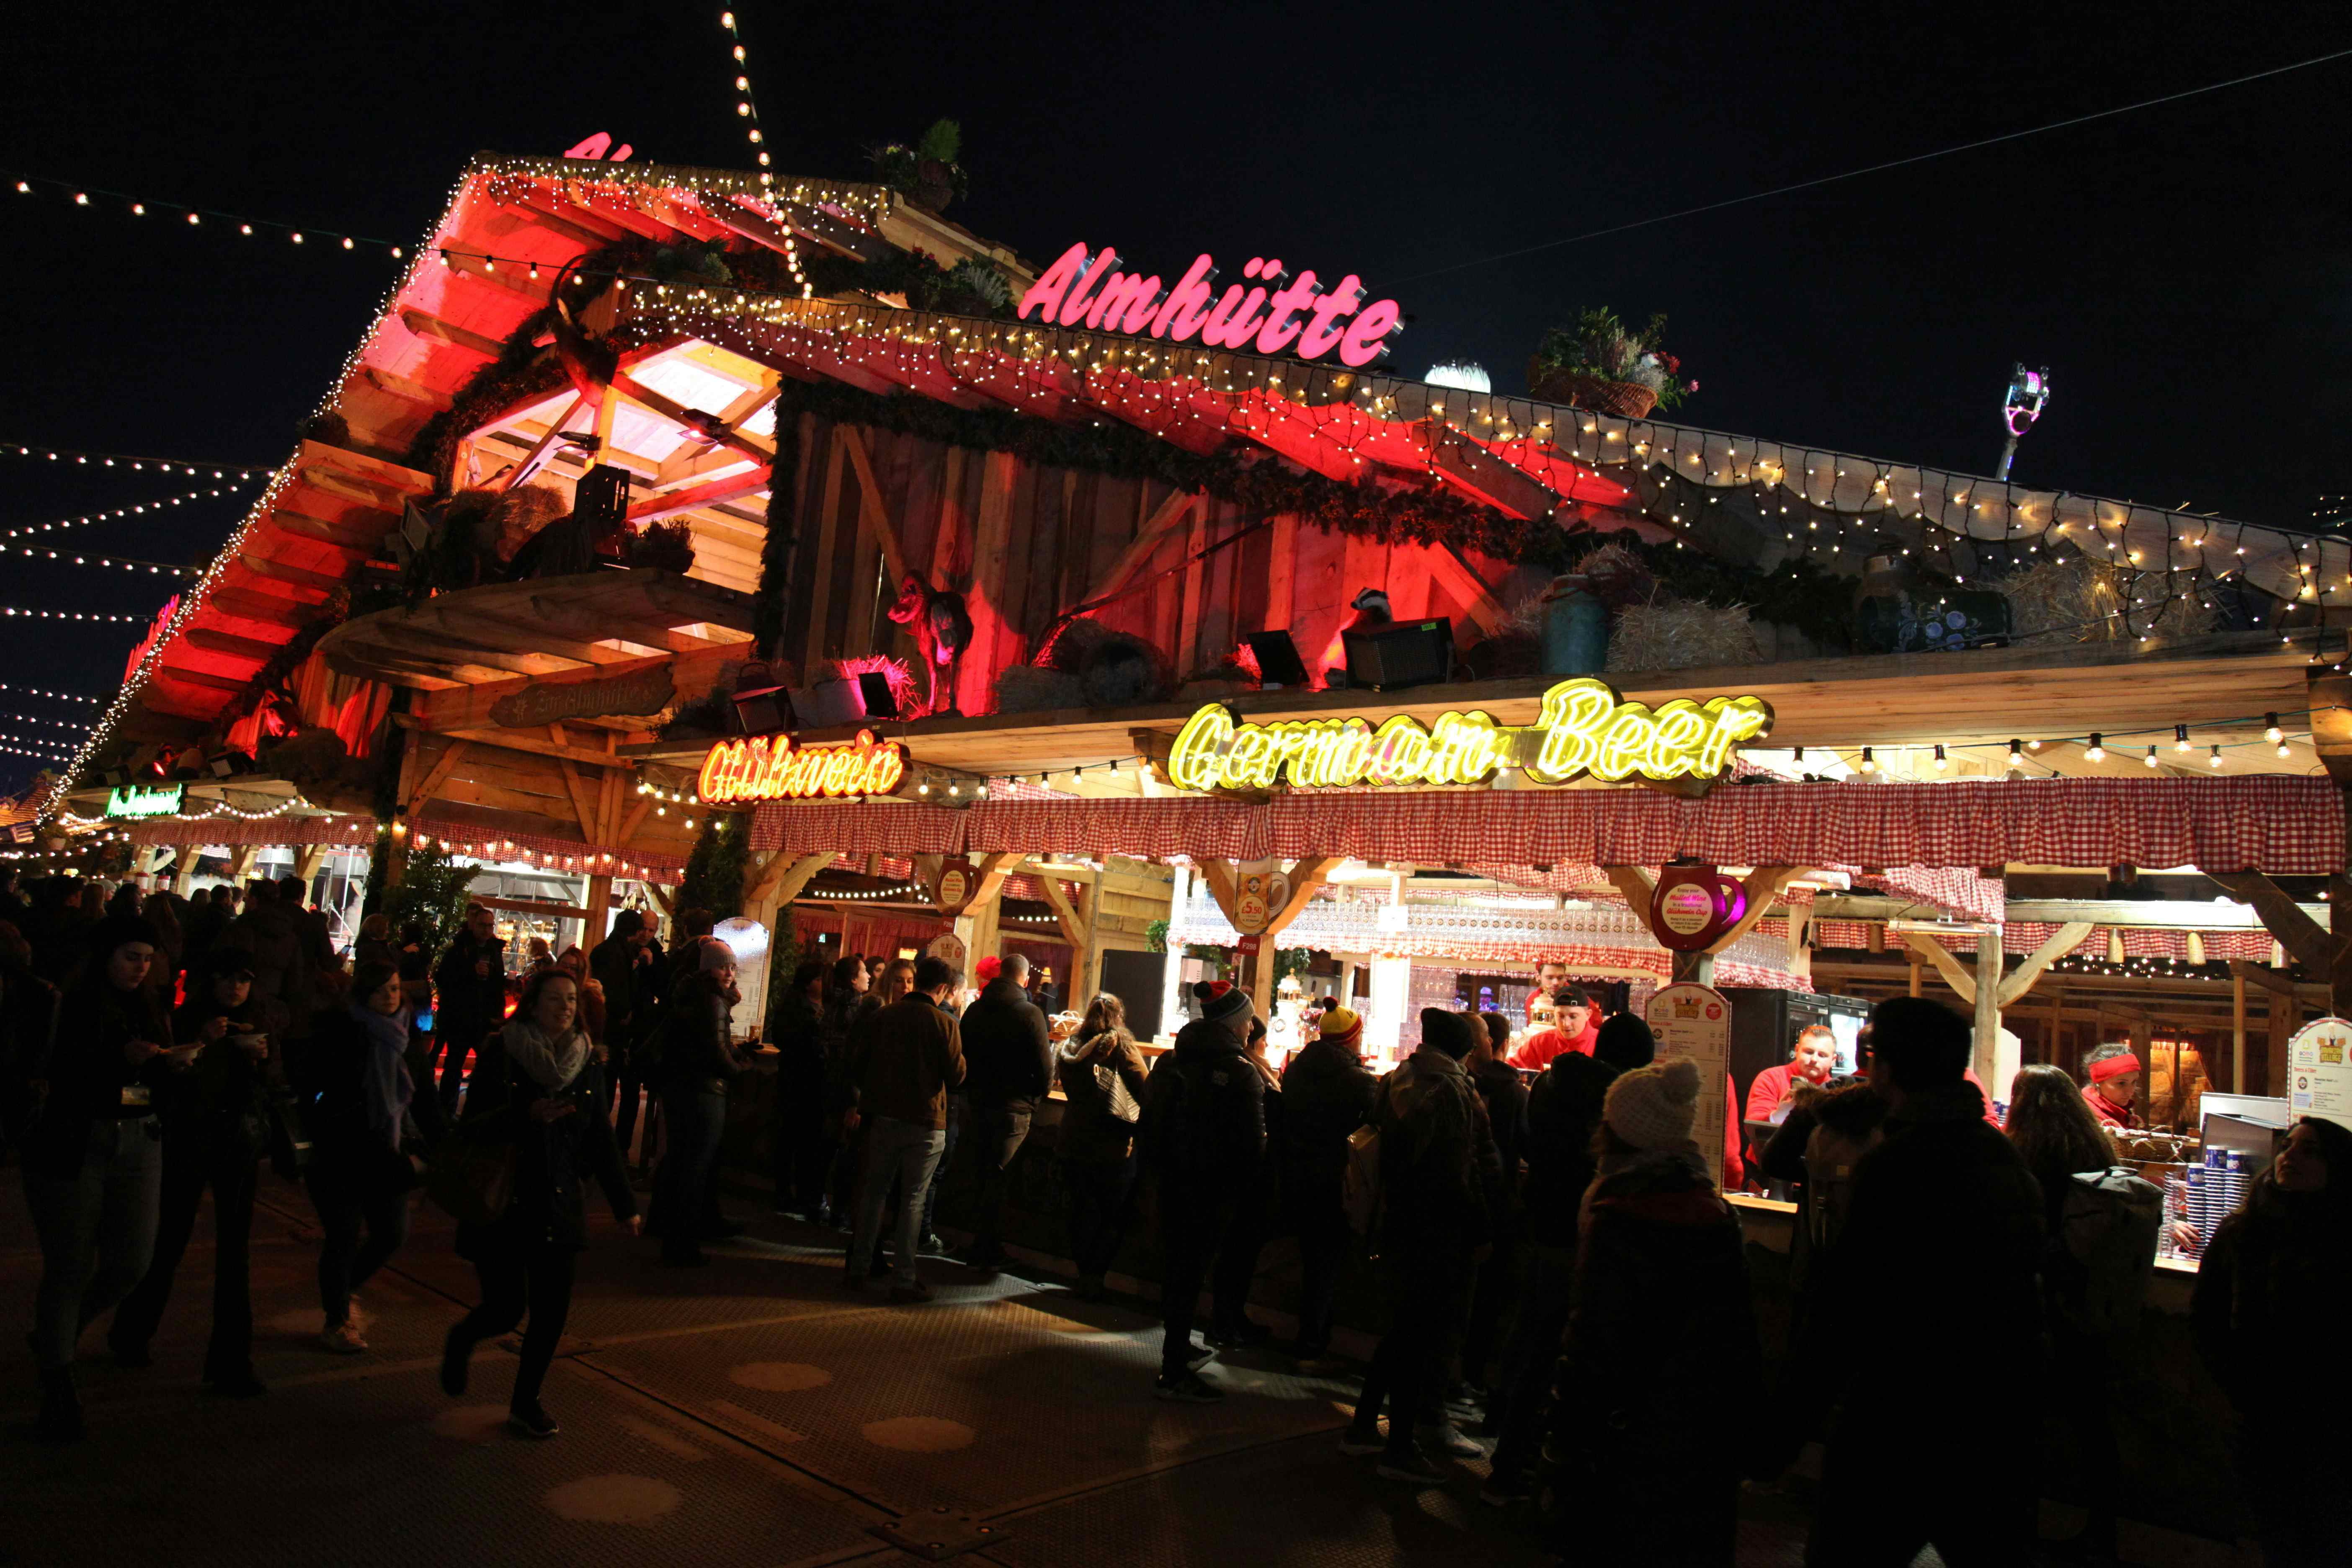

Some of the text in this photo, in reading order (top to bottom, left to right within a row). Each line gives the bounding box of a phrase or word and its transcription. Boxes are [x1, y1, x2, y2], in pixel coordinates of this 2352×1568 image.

[1017, 242, 1400, 367] Almhütte
[1168, 677, 1767, 791] German Beer
[1241, 901, 1262, 914] £5.50
[1242, 942, 1257, 951] F298
